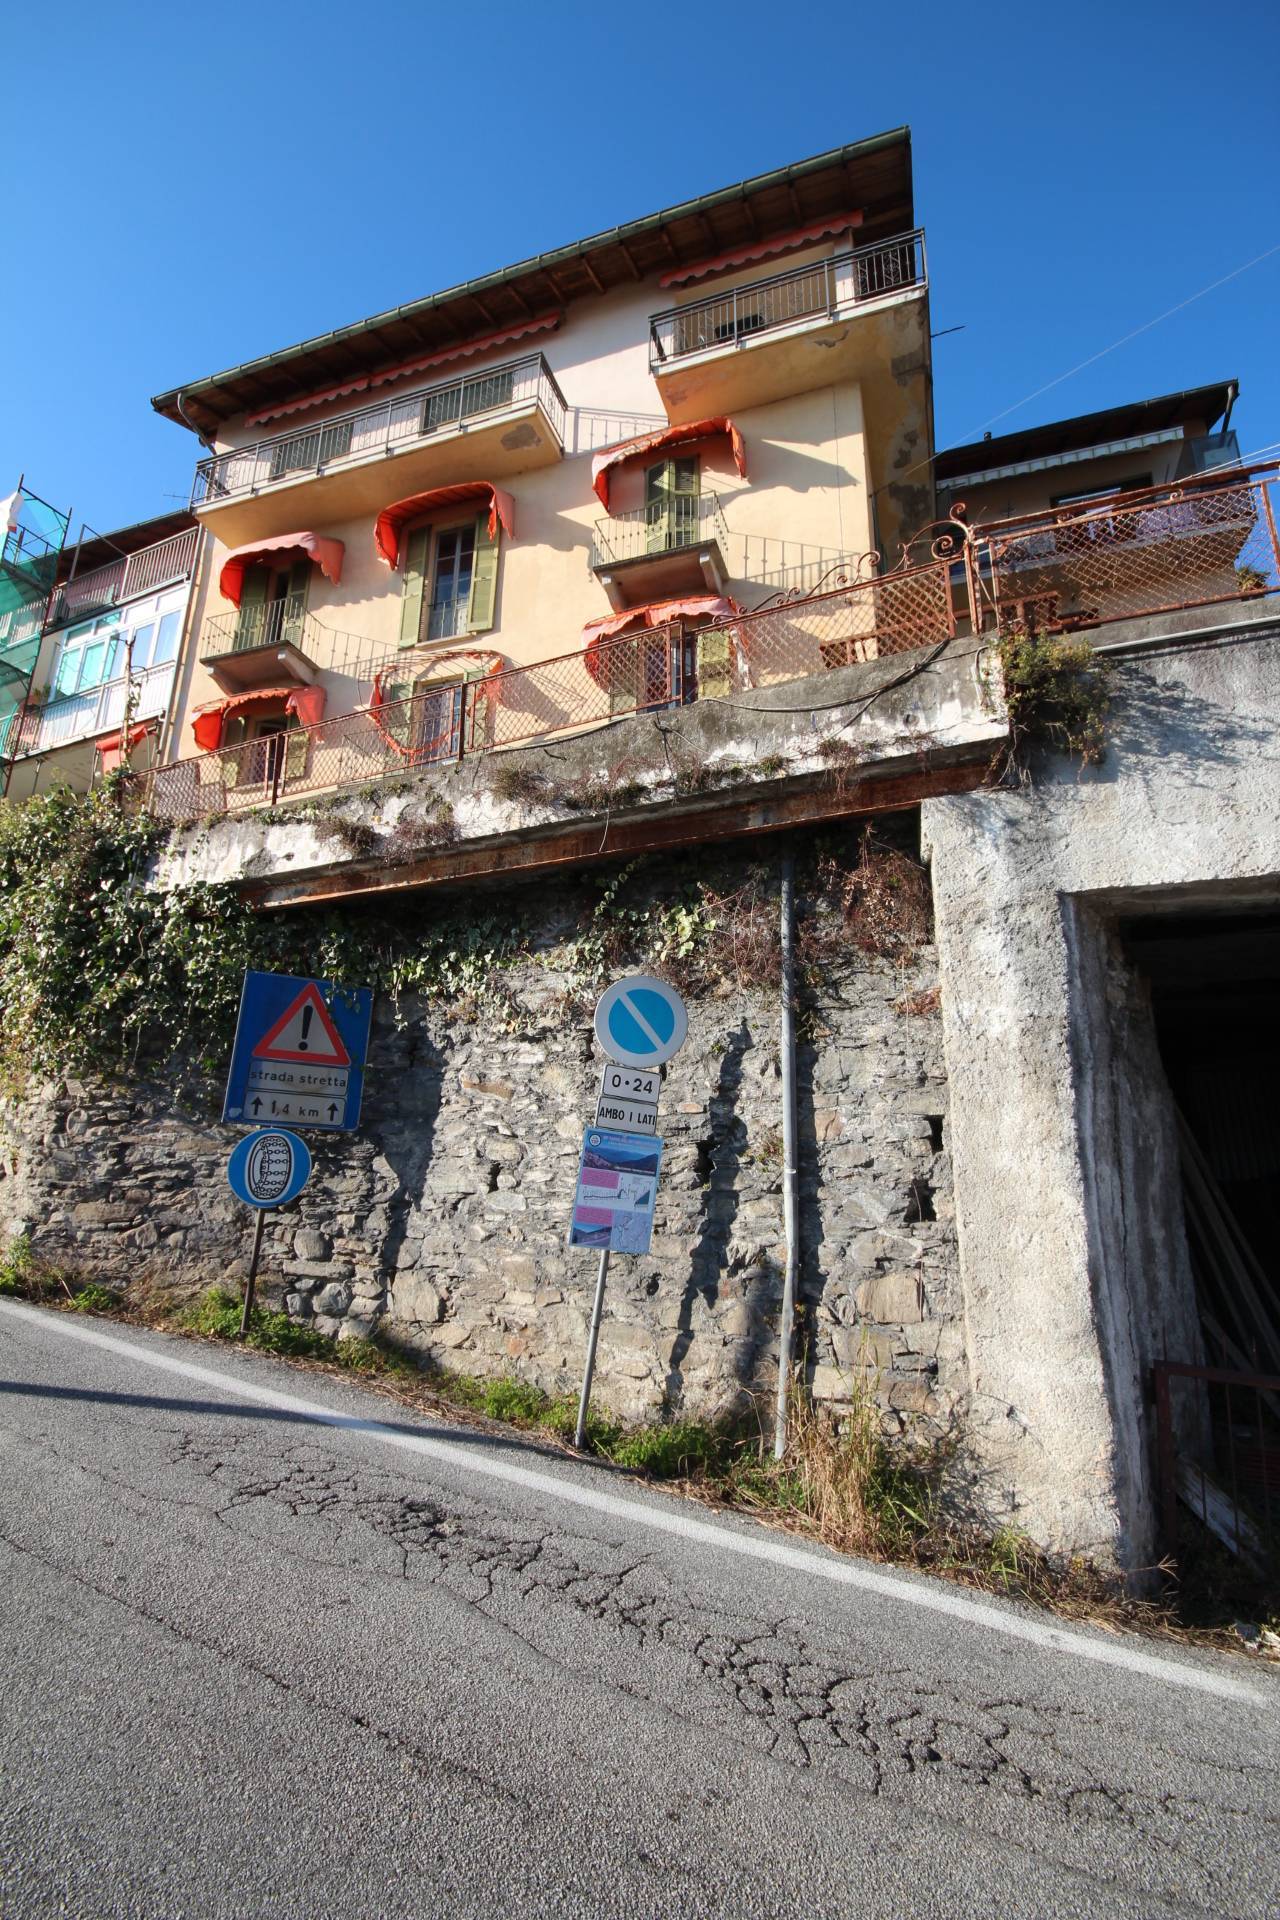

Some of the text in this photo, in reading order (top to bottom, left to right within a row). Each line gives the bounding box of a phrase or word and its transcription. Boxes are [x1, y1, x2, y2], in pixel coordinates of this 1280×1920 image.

[250, 1070, 346, 1087] strada stretta
[271, 1100, 319, 1117] 1,4 km
[599, 1106, 625, 1121] AMBO
[637, 1113, 656, 1125] LATI
